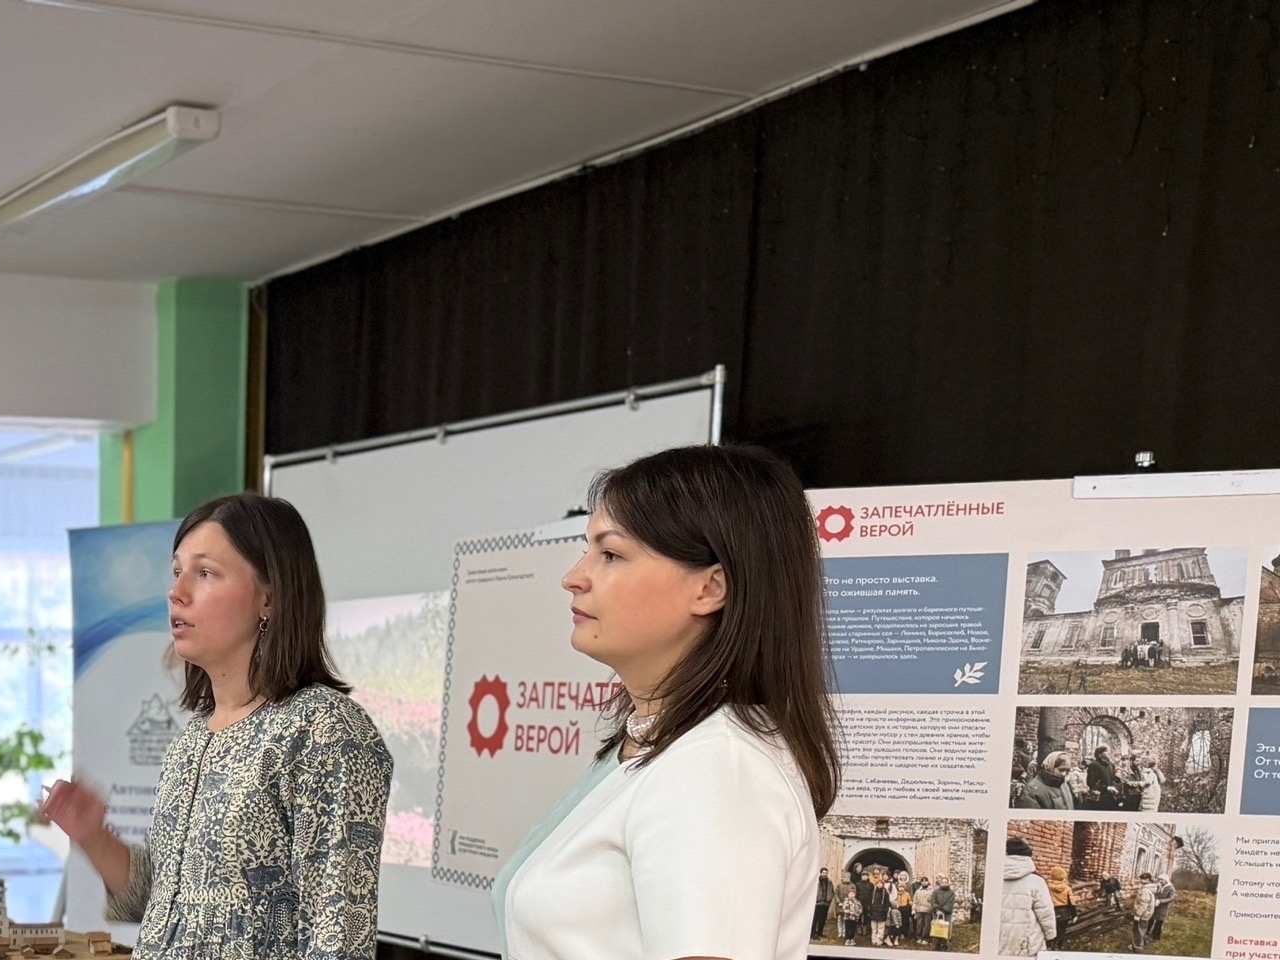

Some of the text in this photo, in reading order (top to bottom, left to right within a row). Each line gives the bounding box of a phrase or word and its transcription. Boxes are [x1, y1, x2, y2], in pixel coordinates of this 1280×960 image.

[860, 501, 1005, 519] ЗАПЕЧАТЛЁННЫЕ
[859, 521, 915, 537] ВЕРОЙ
[823, 576, 839, 585] Это
[855, 577, 890, 586] просто
[892, 575, 938, 584] выставка.
[840, 589, 882, 597] ожившая
[885, 588, 920, 597] память.
[515, 720, 580, 755] ВЕРОЙ
[1256, 743, 1276, 752] Эта
[1255, 756, 1271, 765] От
[1254, 769, 1270, 778] От
[1236, 836, 1250, 844] Мы
[1235, 848, 1268, 856] Увидеть
[1233, 859, 1273, 867] Услышать
[1232, 879, 1265, 888] Потому
[1227, 935, 1278, 947] Выставка
[1225, 950, 1246, 959] при
